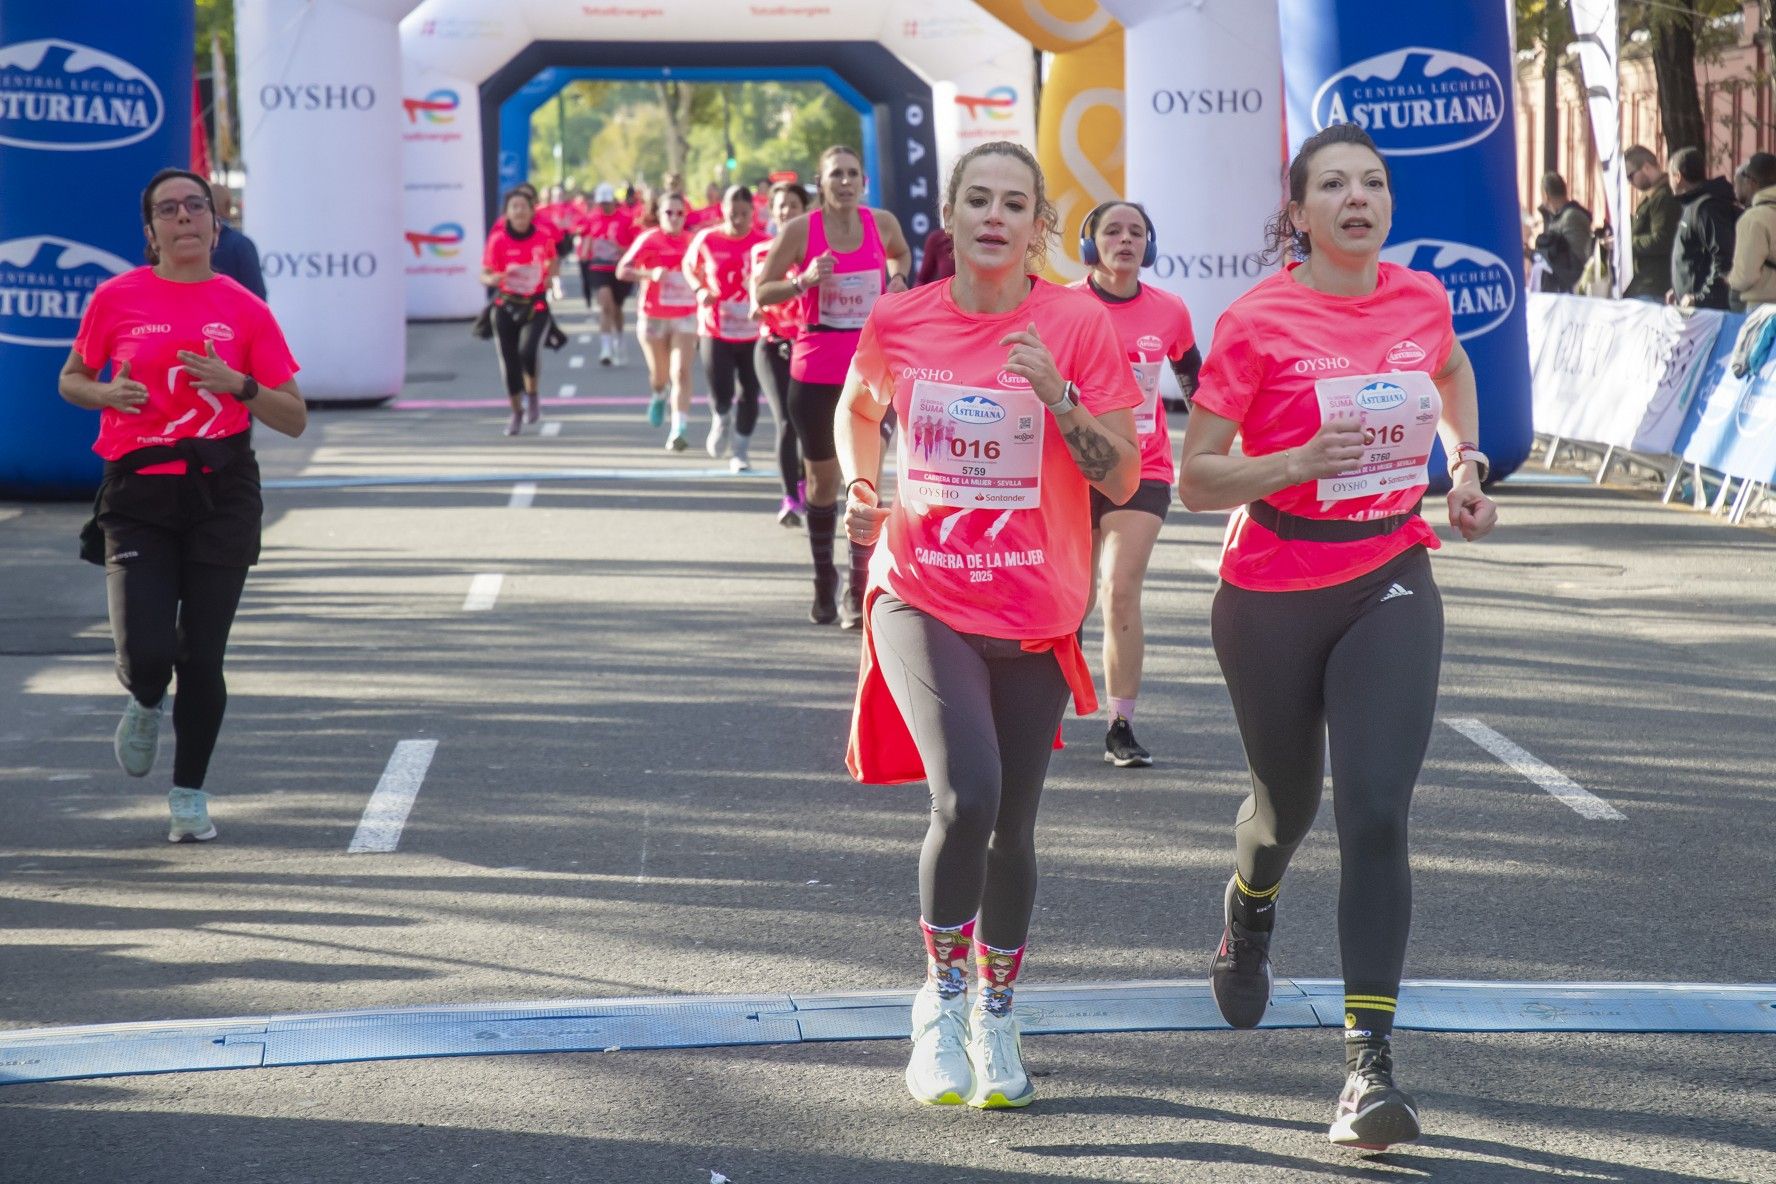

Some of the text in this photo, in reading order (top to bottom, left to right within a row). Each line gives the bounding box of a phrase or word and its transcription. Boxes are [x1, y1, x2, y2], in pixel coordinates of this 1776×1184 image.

[0, 74, 63, 90] ENTRAL
[1353, 79, 1491, 99] CENTRAL LECHERA
[260, 84, 376, 111] OYSHO
[1152, 88, 1263, 115] OYSHO
[1327, 91, 1496, 130] ASTURIANA
[262, 252, 377, 279] OYSHO
[1153, 253, 1263, 279] OYSHO
[840, 295, 863, 305] 016
[131, 323, 171, 336] OYSHO
[1295, 357, 1350, 373] OYSHO
[903, 367, 953, 382] OYSHO
[1329, 400, 1354, 408] SUMA
[1361, 393, 1404, 405] ASTURIANA
[920, 403, 944, 413] SUMA
[952, 405, 1001, 418] ASTURIANA
[1363, 424, 1405, 446] 016
[951, 438, 1001, 460] 016
[1370, 452, 1391, 462] 5760
[924, 473, 951, 483] CARRERA
[962, 466, 986, 476] 5759
[919, 486, 959, 500] OYSHO
[1332, 480, 1368, 493] OYSHO
[985, 493, 1026, 502] Santander
[915, 547, 1045, 569] CARRERA DE LA MUJER
[970, 570, 993, 583] 2025
